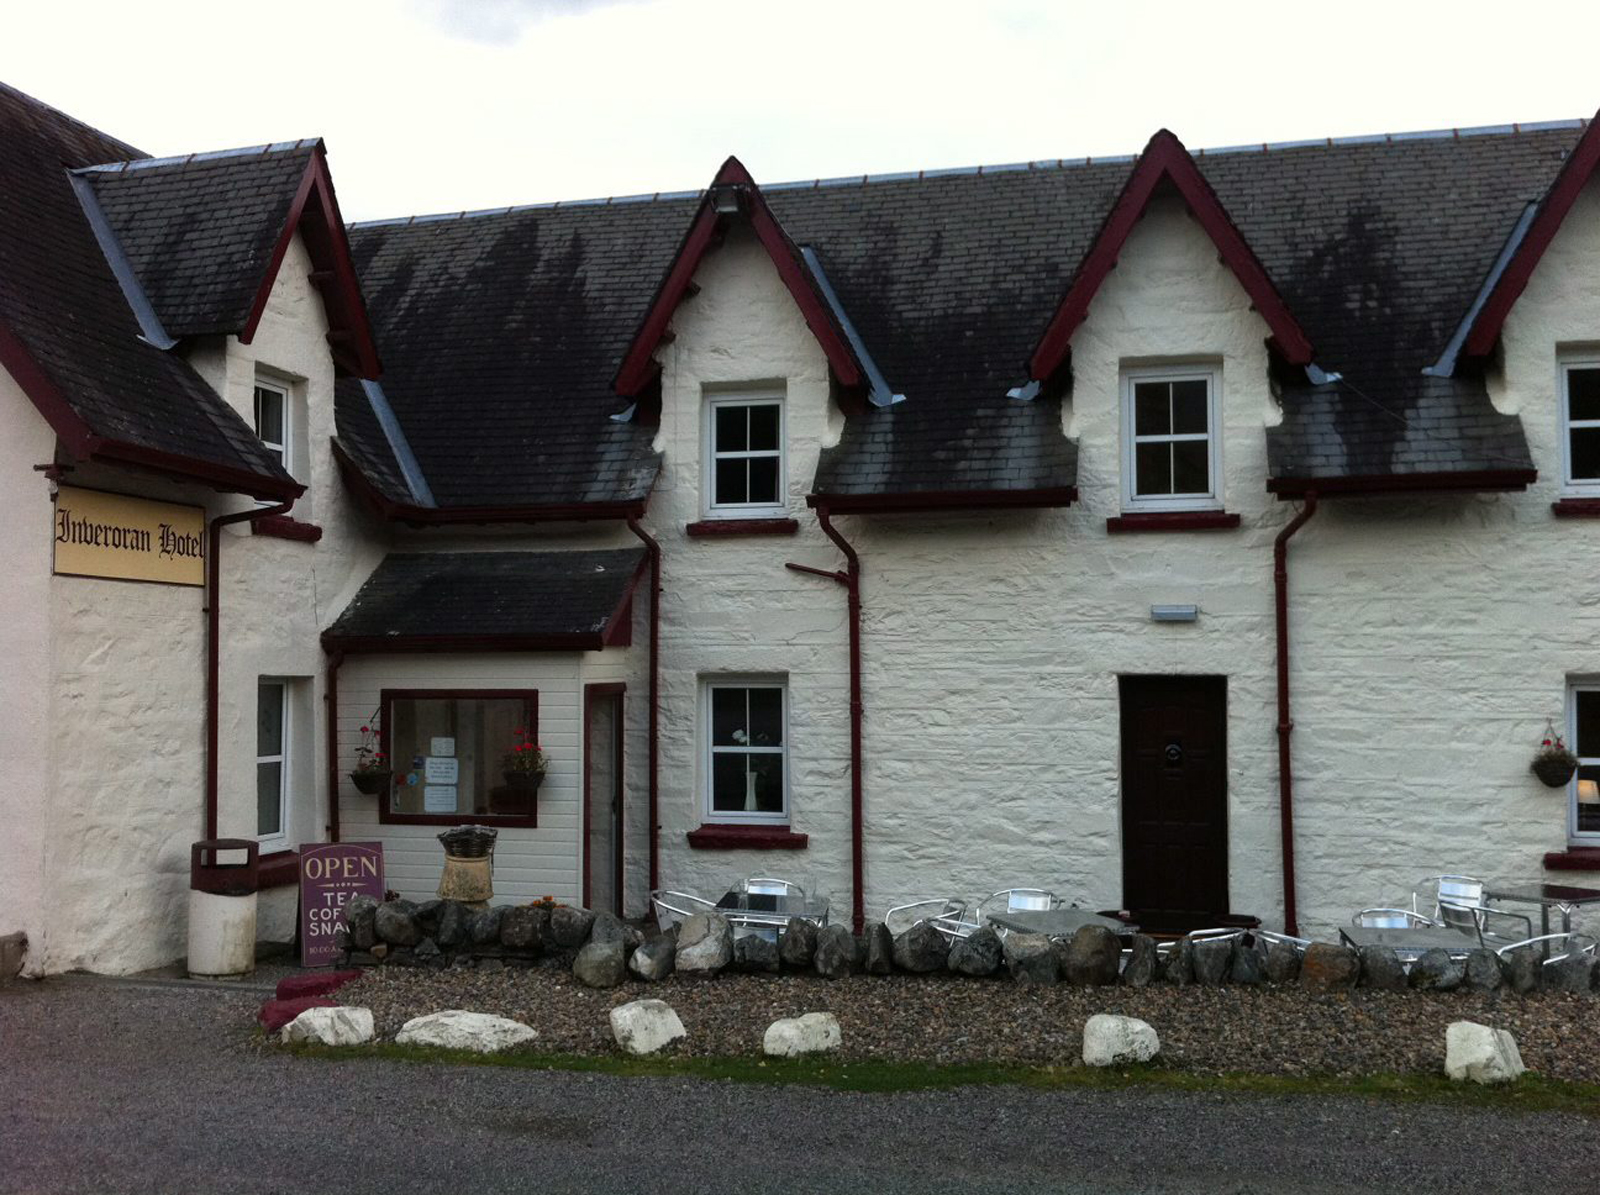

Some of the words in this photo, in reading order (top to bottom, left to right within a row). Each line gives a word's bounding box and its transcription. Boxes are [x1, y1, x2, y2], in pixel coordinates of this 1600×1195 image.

[56, 508, 151, 552] Inveroran
[157, 522, 204, 561] Hotel
[305, 856, 377, 879] OPEN
